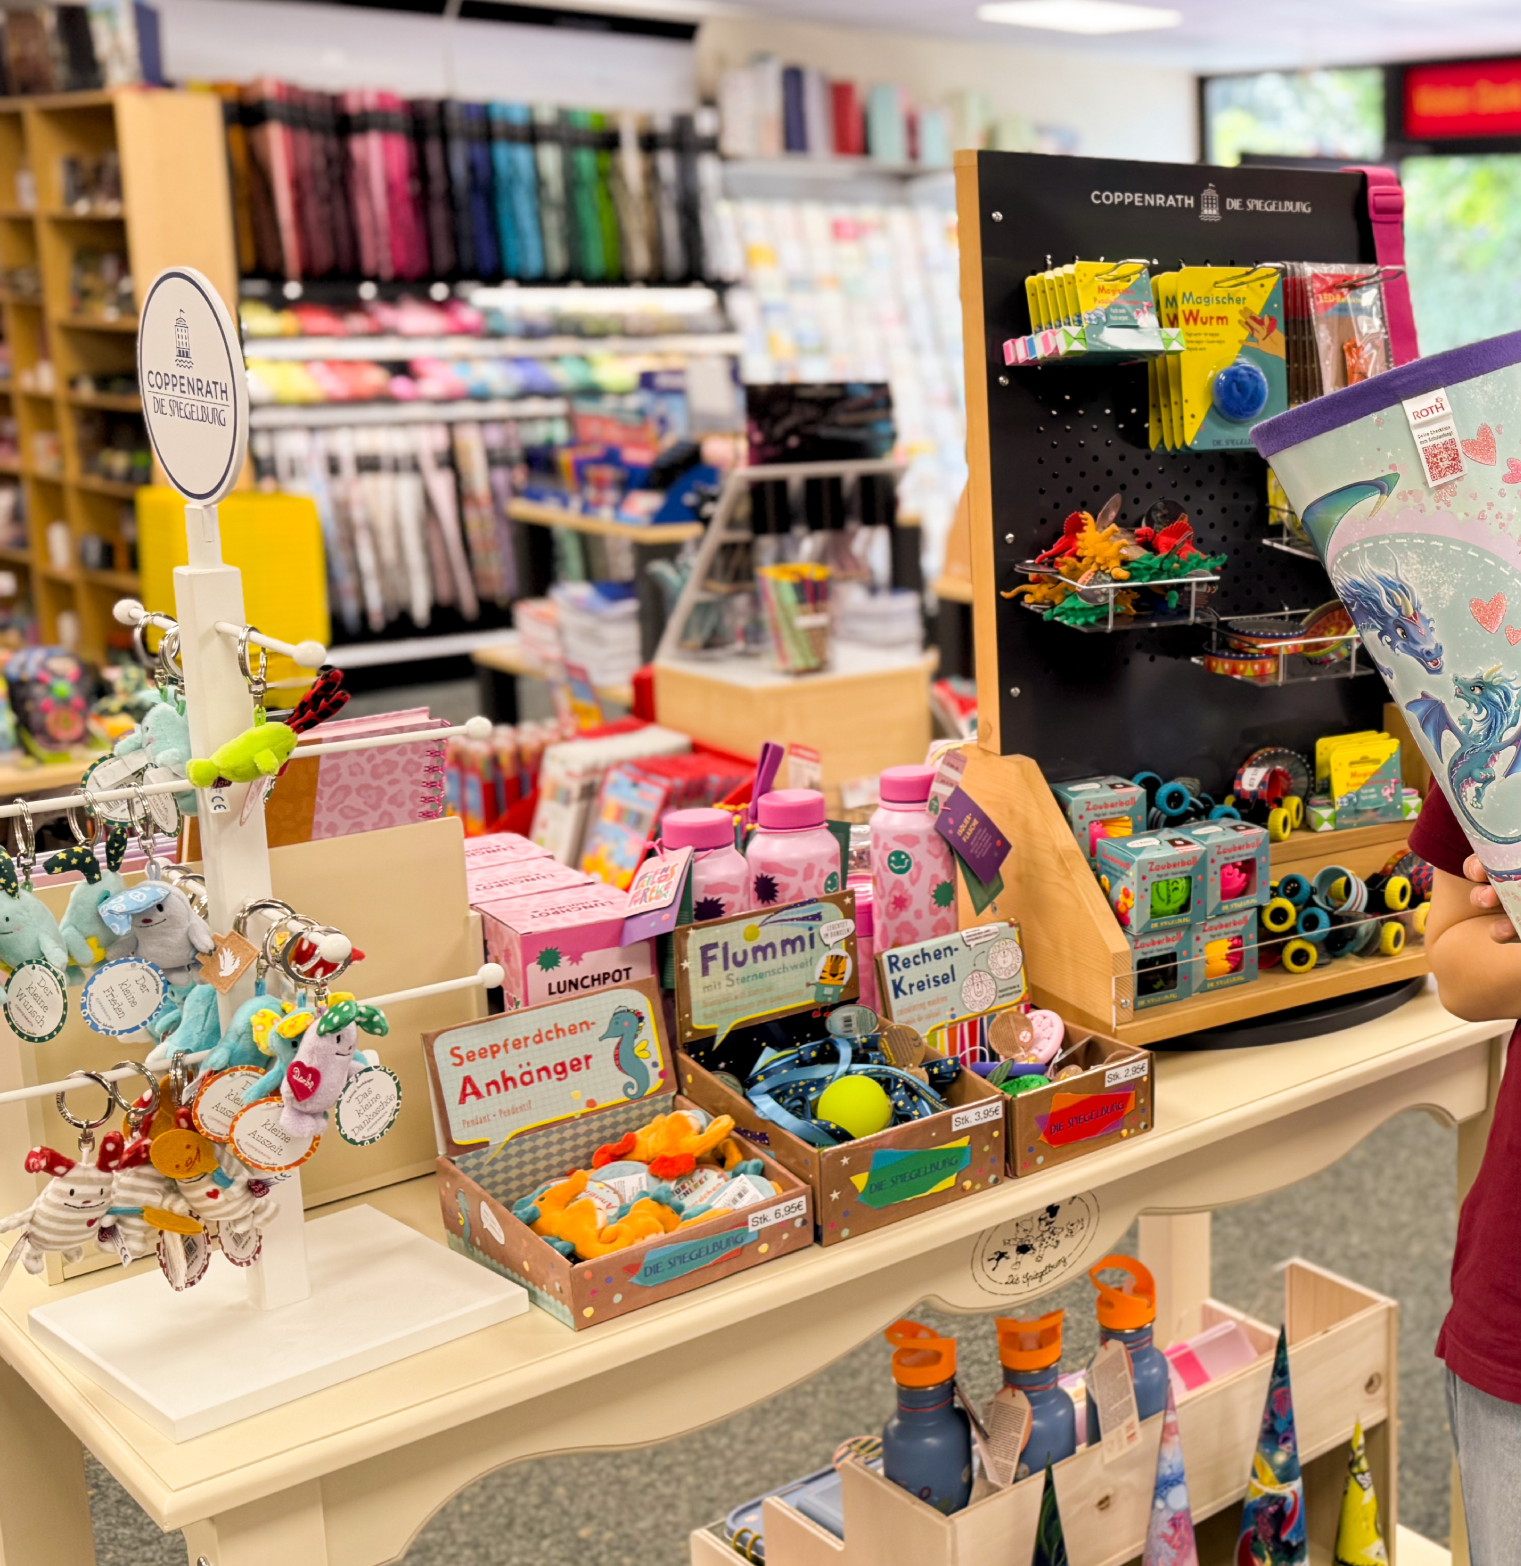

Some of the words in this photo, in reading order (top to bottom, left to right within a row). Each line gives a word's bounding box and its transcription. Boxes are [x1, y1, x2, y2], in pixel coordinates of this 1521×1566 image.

[1090, 190, 1194, 208] COPPENRATH
[1226, 197, 1243, 211] DIE
[1246, 199, 1312, 214] SPIEGELBURG
[1181, 292, 1247, 306] Magischer
[1182, 309, 1229, 326] Wurm
[147, 370, 229, 402] COPPENRATH
[153, 396, 167, 415] DIE
[169, 399, 226, 426] SPIEGELBURG
[1412, 402, 1445, 420] ROTH
[1148, 856, 1198, 871] Zauberball
[531, 901, 614, 919] LUNCHPOT
[1202, 916, 1249, 933] Zauberball
[699, 926, 815, 977] Flummi
[1133, 932, 1183, 950] Zauberball
[887, 945, 959, 974] Rechen-
[36, 976, 53, 997] Der
[135, 975, 149, 994] Der
[547, 966, 633, 996] LUNCHPOT
[702, 980, 722, 994] mit
[725, 956, 814, 987] Sternenschweif
[891, 964, 956, 1000] Kreisel
[25, 981, 49, 1013] kleine
[103, 986, 126, 1019] Frieden
[118, 979, 137, 1008] kleine
[15, 988, 45, 1028] Wunsch
[449, 1020, 597, 1067] Seepferdchen-
[458, 1054, 593, 1105] Anhänger
[1107, 1071, 1123, 1084] Stk.
[1124, 1062, 1147, 1080] 2,95€
[355, 1087, 373, 1105] Das
[357, 1092, 381, 1118] kleine
[351, 1093, 396, 1137] Dankeschön
[462, 1113, 490, 1129] Pendant
[500, 1099, 533, 1118] Pendentif
[954, 1113, 972, 1127] Stk.
[974, 1104, 1001, 1122] 3,95€
[1050, 1121, 1064, 1135] DIE
[1067, 1100, 1125, 1130] SPIEGELBURG
[247, 1129, 284, 1156] Auszeit
[261, 1119, 292, 1144] kleine
[869, 1179, 888, 1196] DIE
[890, 1154, 959, 1188] SPIEGELBURG
[751, 1214, 772, 1227] Stk.
[774, 1200, 804, 1220] 6,95€
[643, 1258, 664, 1278] DIE
[667, 1233, 744, 1270] SPIEGELBURG
[1004, 1274, 1020, 1285] Die
